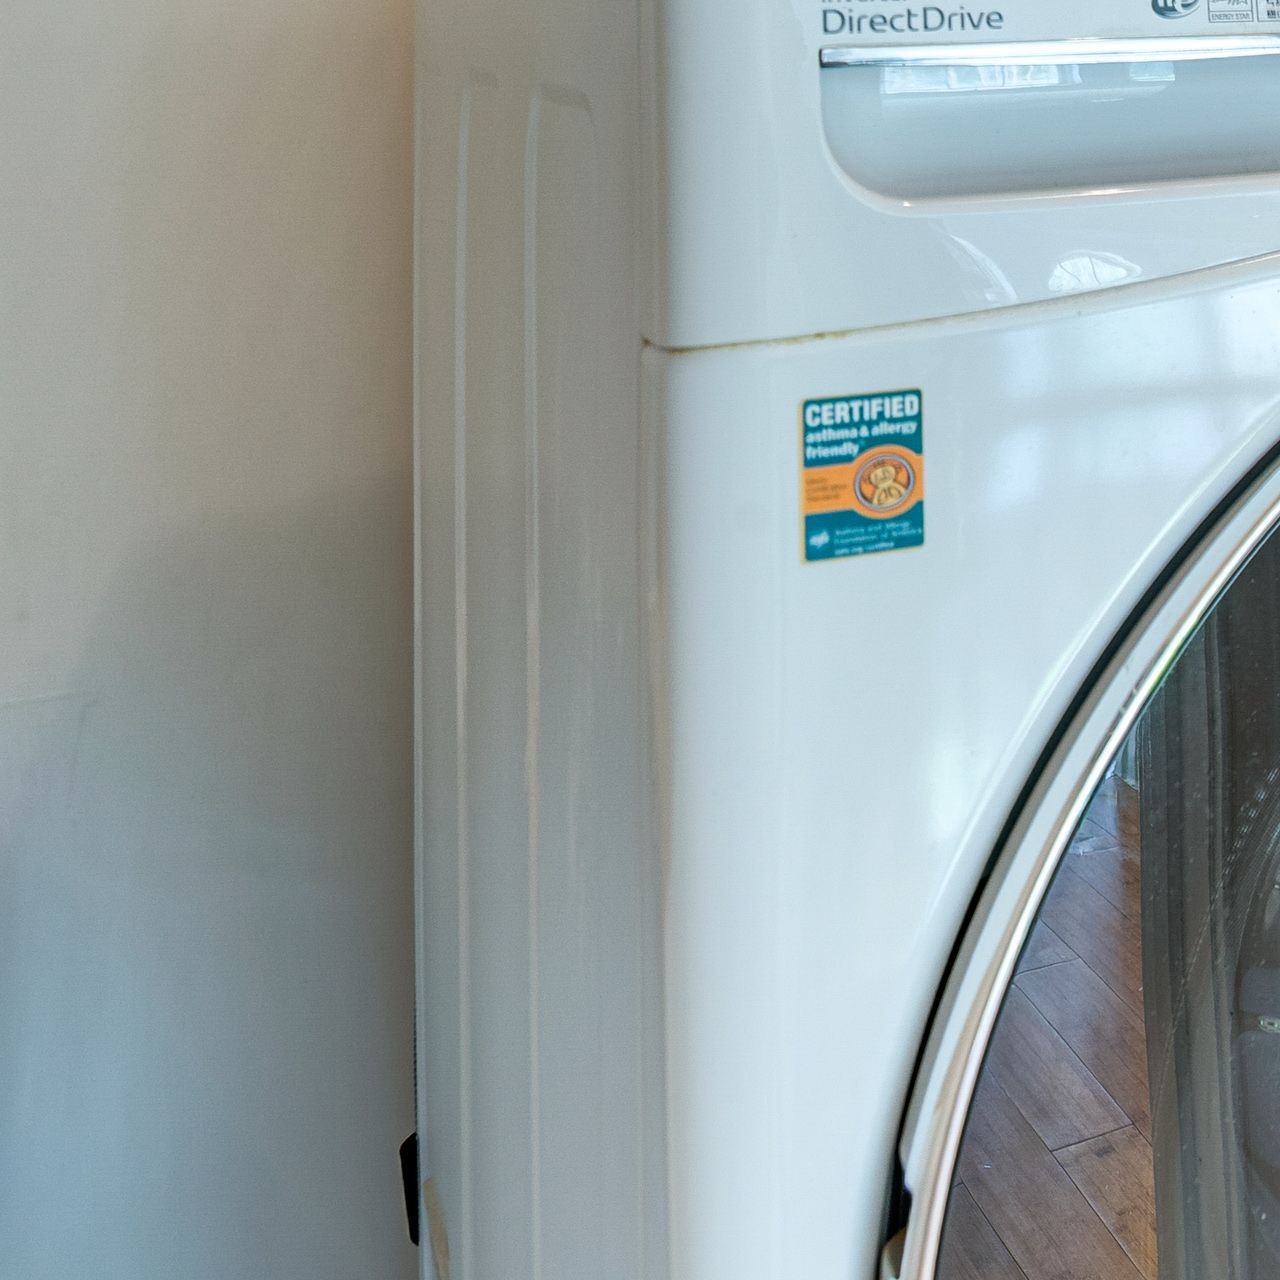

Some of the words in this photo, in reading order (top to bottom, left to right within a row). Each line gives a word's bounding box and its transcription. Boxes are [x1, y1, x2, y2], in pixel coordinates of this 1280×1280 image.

[1235, 12, 1250, 20] STAR
[806, 394, 919, 426] CERTIFIED
[806, 426, 858, 443] asthma
[860, 426, 870, 438] &
[871, 420, 918, 437] allergy
